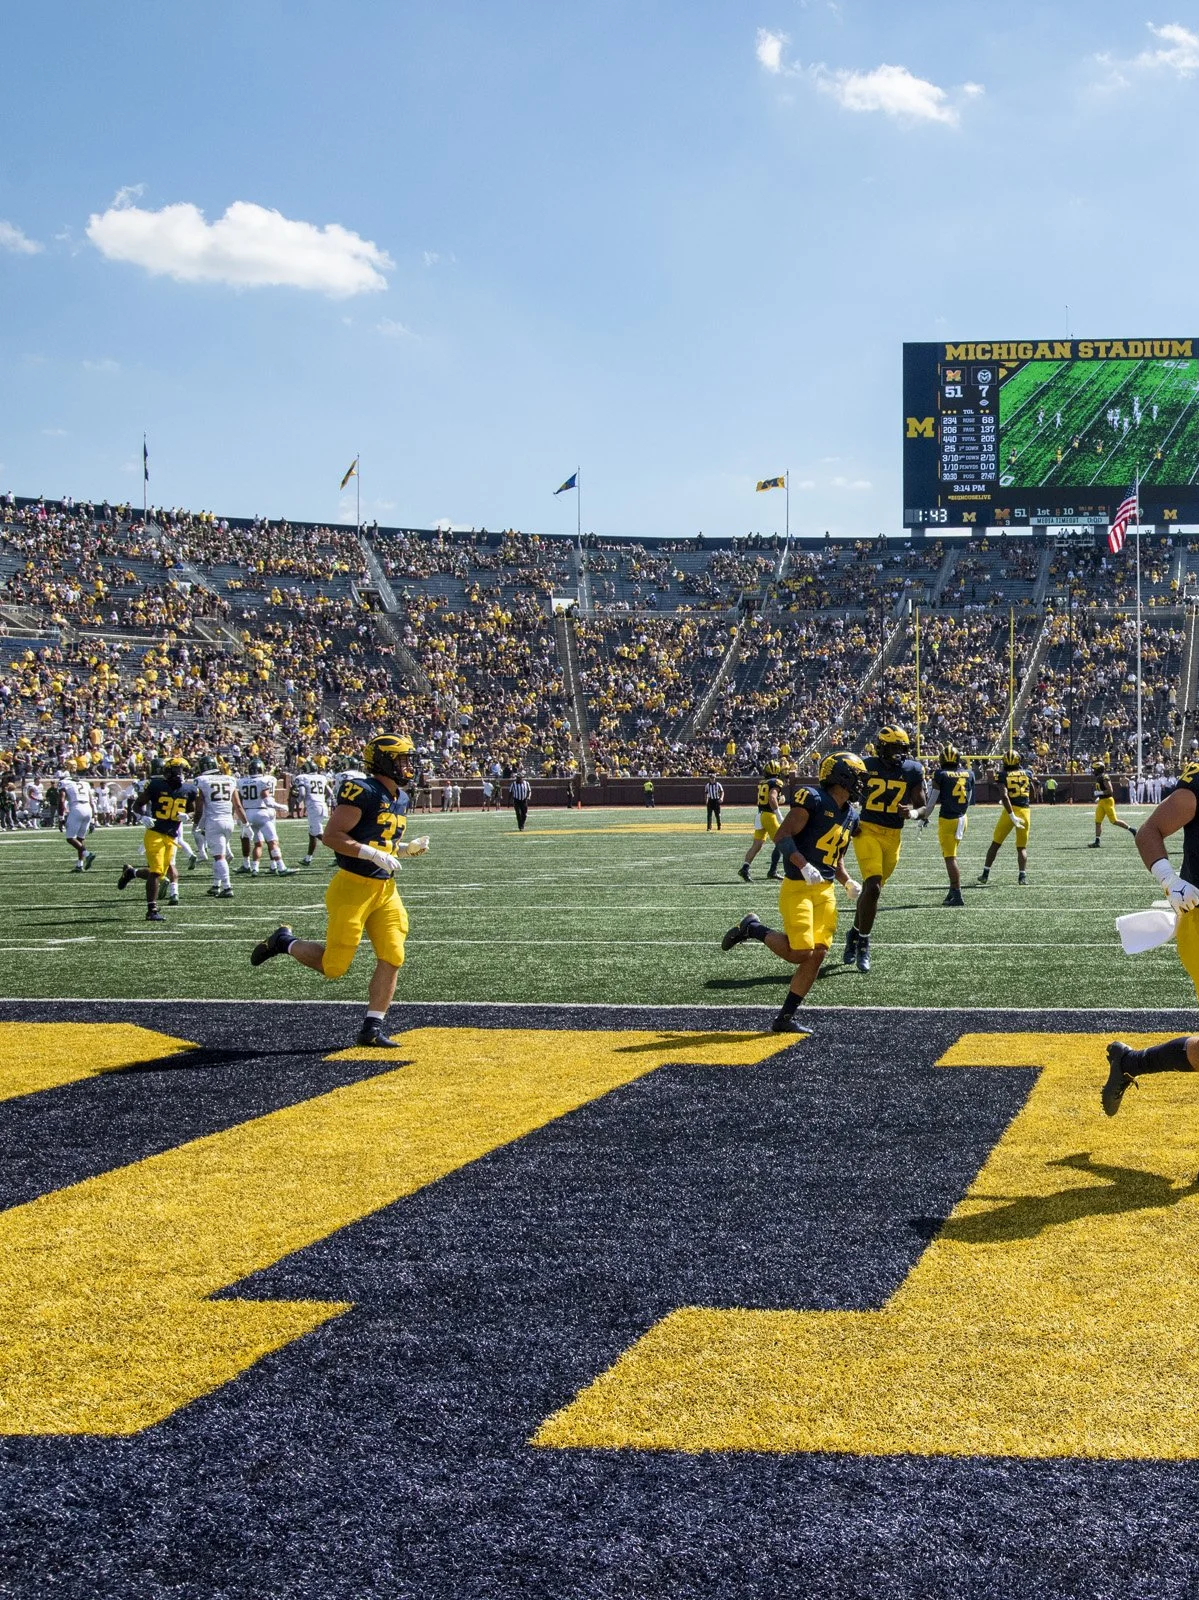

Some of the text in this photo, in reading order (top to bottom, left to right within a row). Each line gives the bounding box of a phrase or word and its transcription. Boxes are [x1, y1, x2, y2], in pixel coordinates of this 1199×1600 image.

[945, 340, 1193, 361] MICHIGAN STADIUM
[945, 386, 989, 398] 51 7
[906, 417, 935, 438] M
[919, 508, 948, 522] 1:43
[962, 512, 977, 522] M
[1015, 508, 1027, 517] 51
[1163, 509, 1178, 520] M
[210, 783, 231, 802] 25
[242, 785, 258, 800] 30
[310, 780, 323, 794] 26
[341, 781, 364, 801] 37
[794, 788, 810, 805] 41
[865, 778, 907, 814] 27
[952, 777, 967, 804] 4
[1006, 776, 1030, 798] 52
[155, 796, 187, 822] 36
[368, 812, 407, 858] 37
[815, 823, 851, 868] 41
